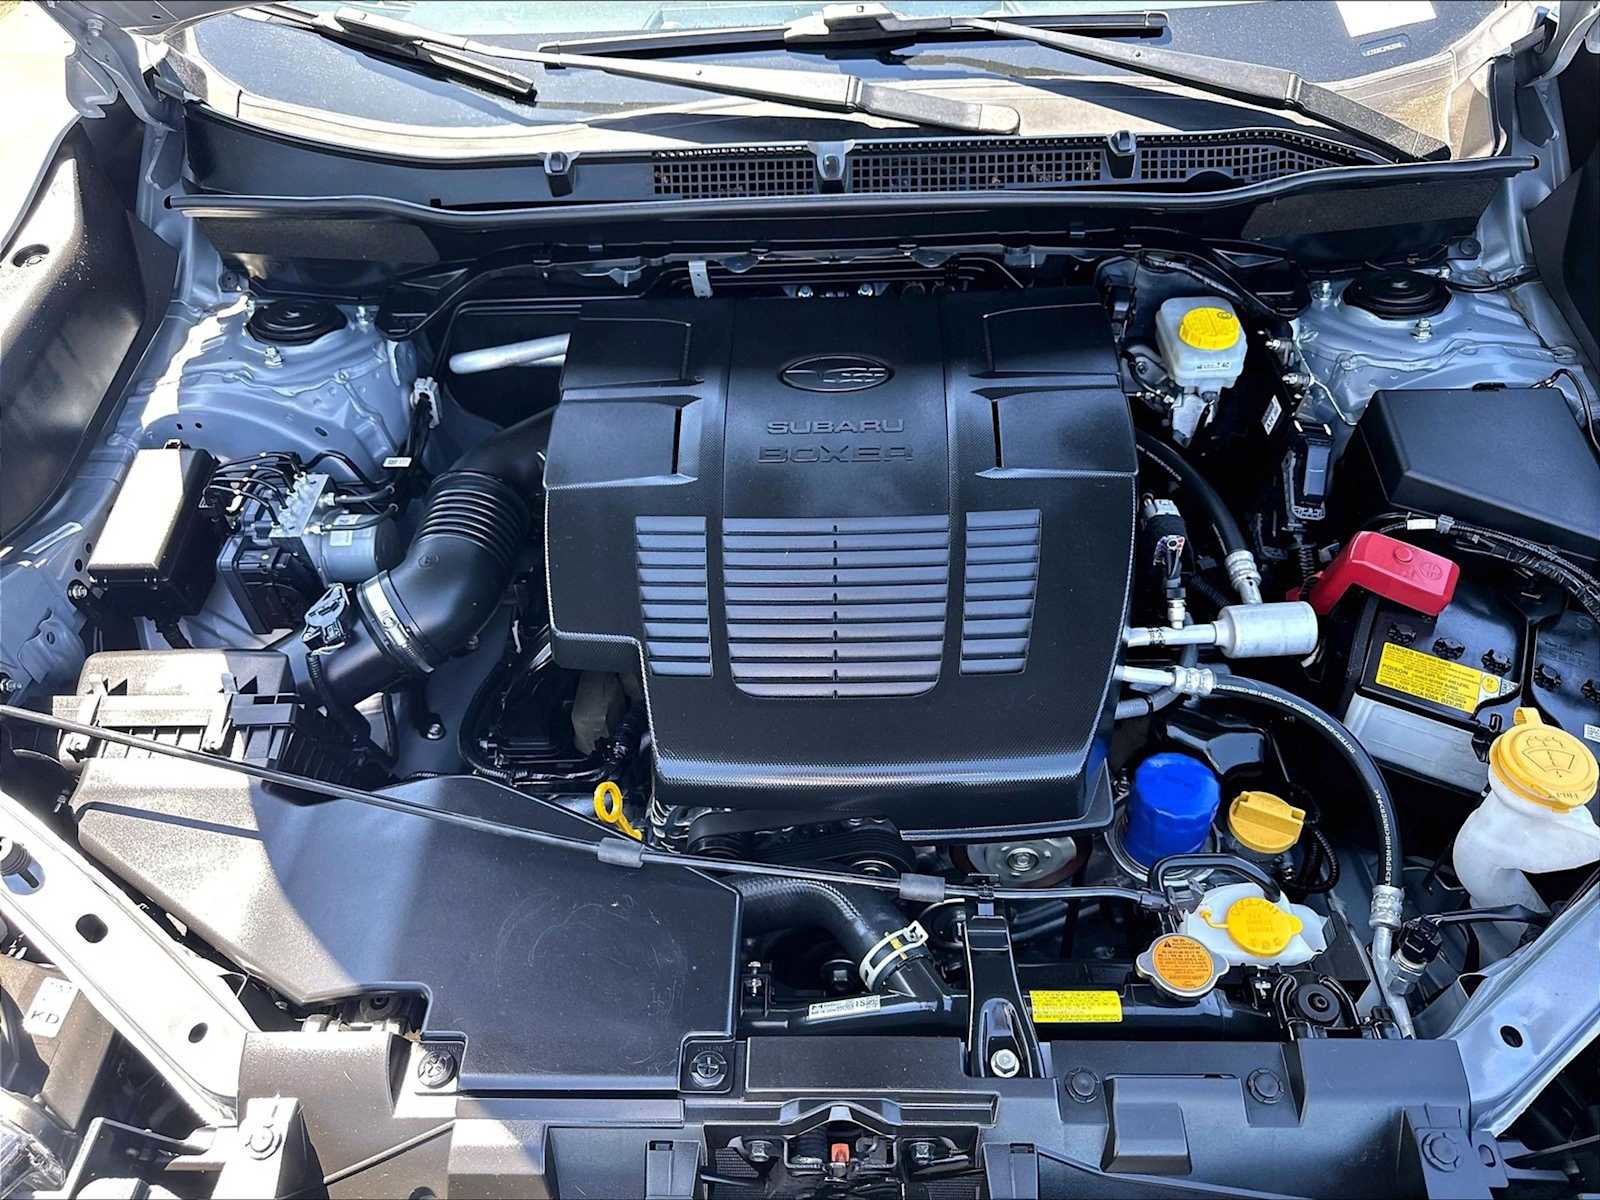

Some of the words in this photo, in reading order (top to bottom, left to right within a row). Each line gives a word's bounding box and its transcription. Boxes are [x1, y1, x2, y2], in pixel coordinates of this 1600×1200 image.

[767, 418, 904, 434] SUBARU
[758, 445, 913, 464] BOXER
[1386, 644, 1414, 656] DANGER
